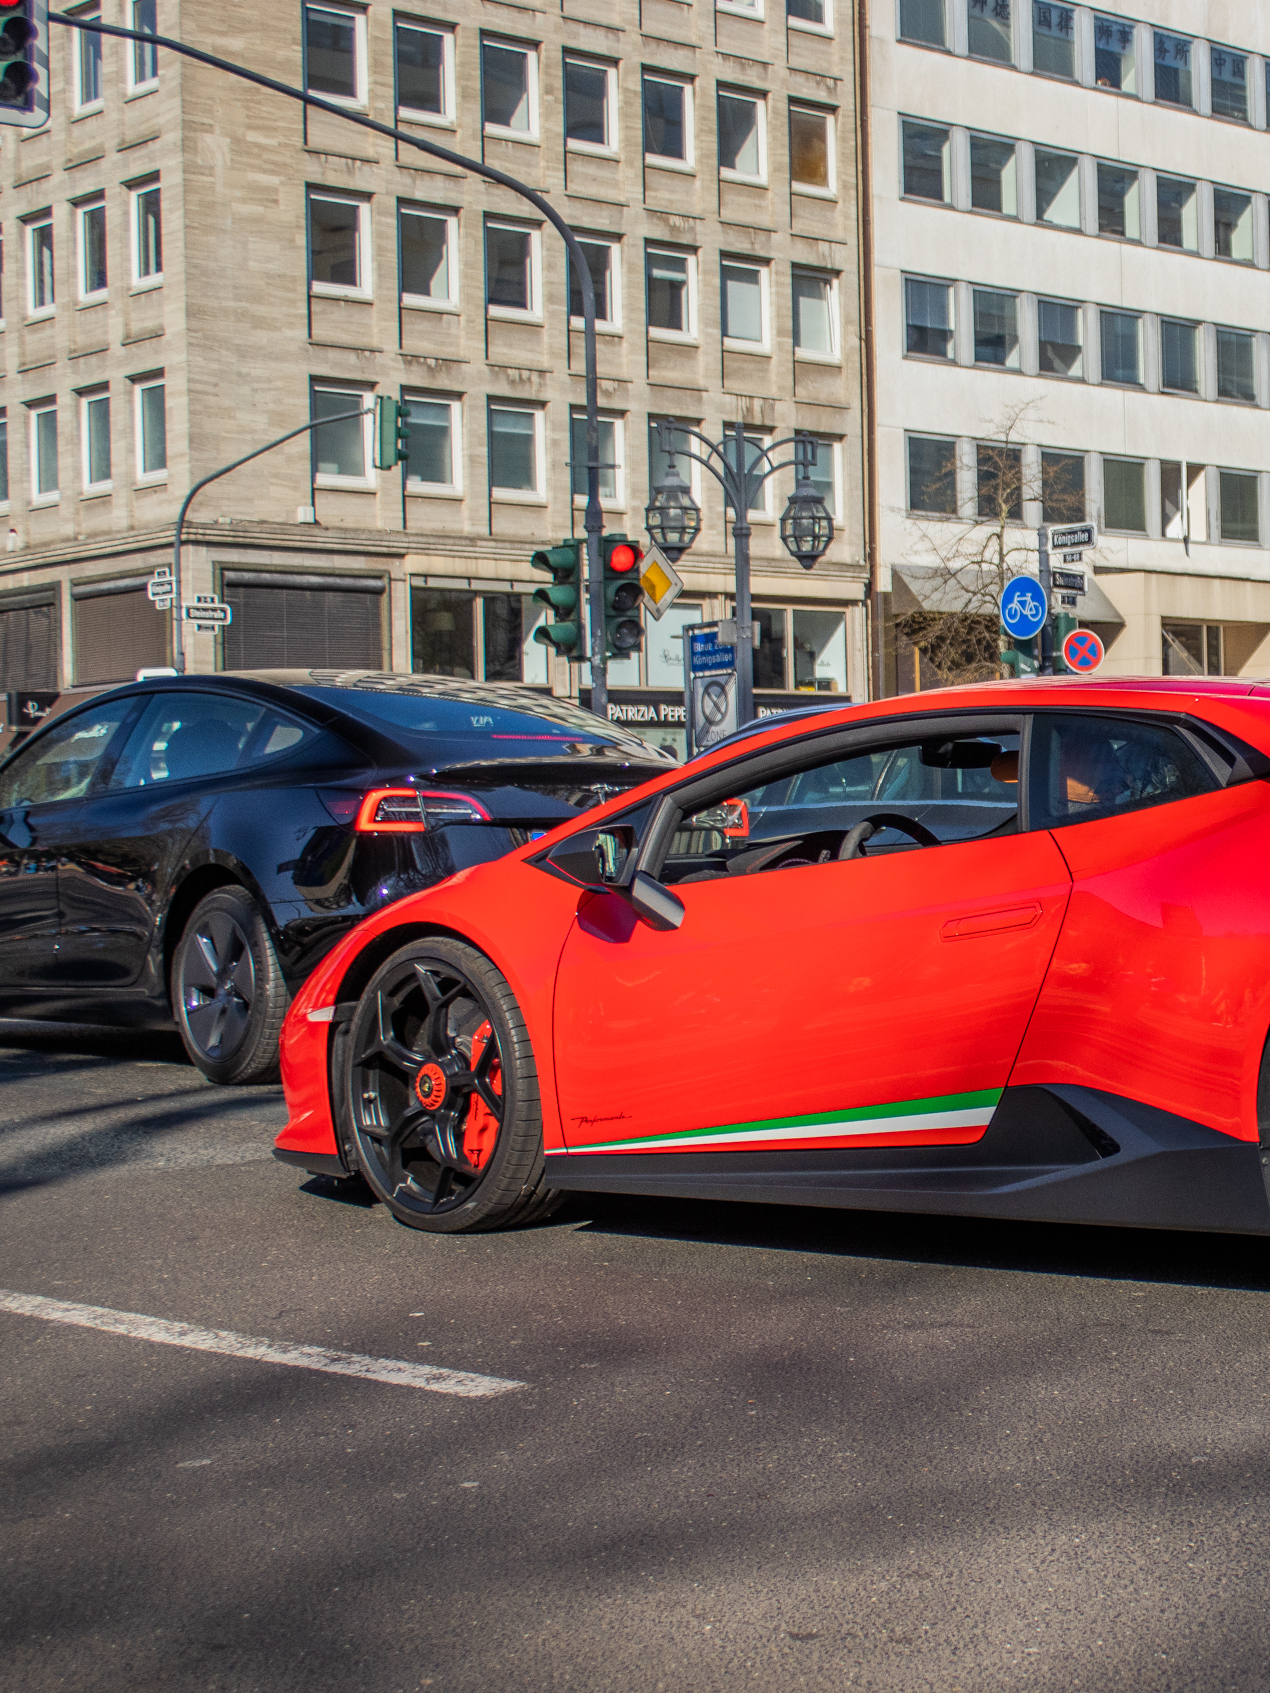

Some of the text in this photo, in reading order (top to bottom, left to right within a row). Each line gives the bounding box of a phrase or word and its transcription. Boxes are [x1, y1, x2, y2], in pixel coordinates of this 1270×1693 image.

[1054, 532, 1089, 546] Königsallee
[693, 653, 733, 666] Königsallee
[607, 703, 658, 721] PATRIZIA
